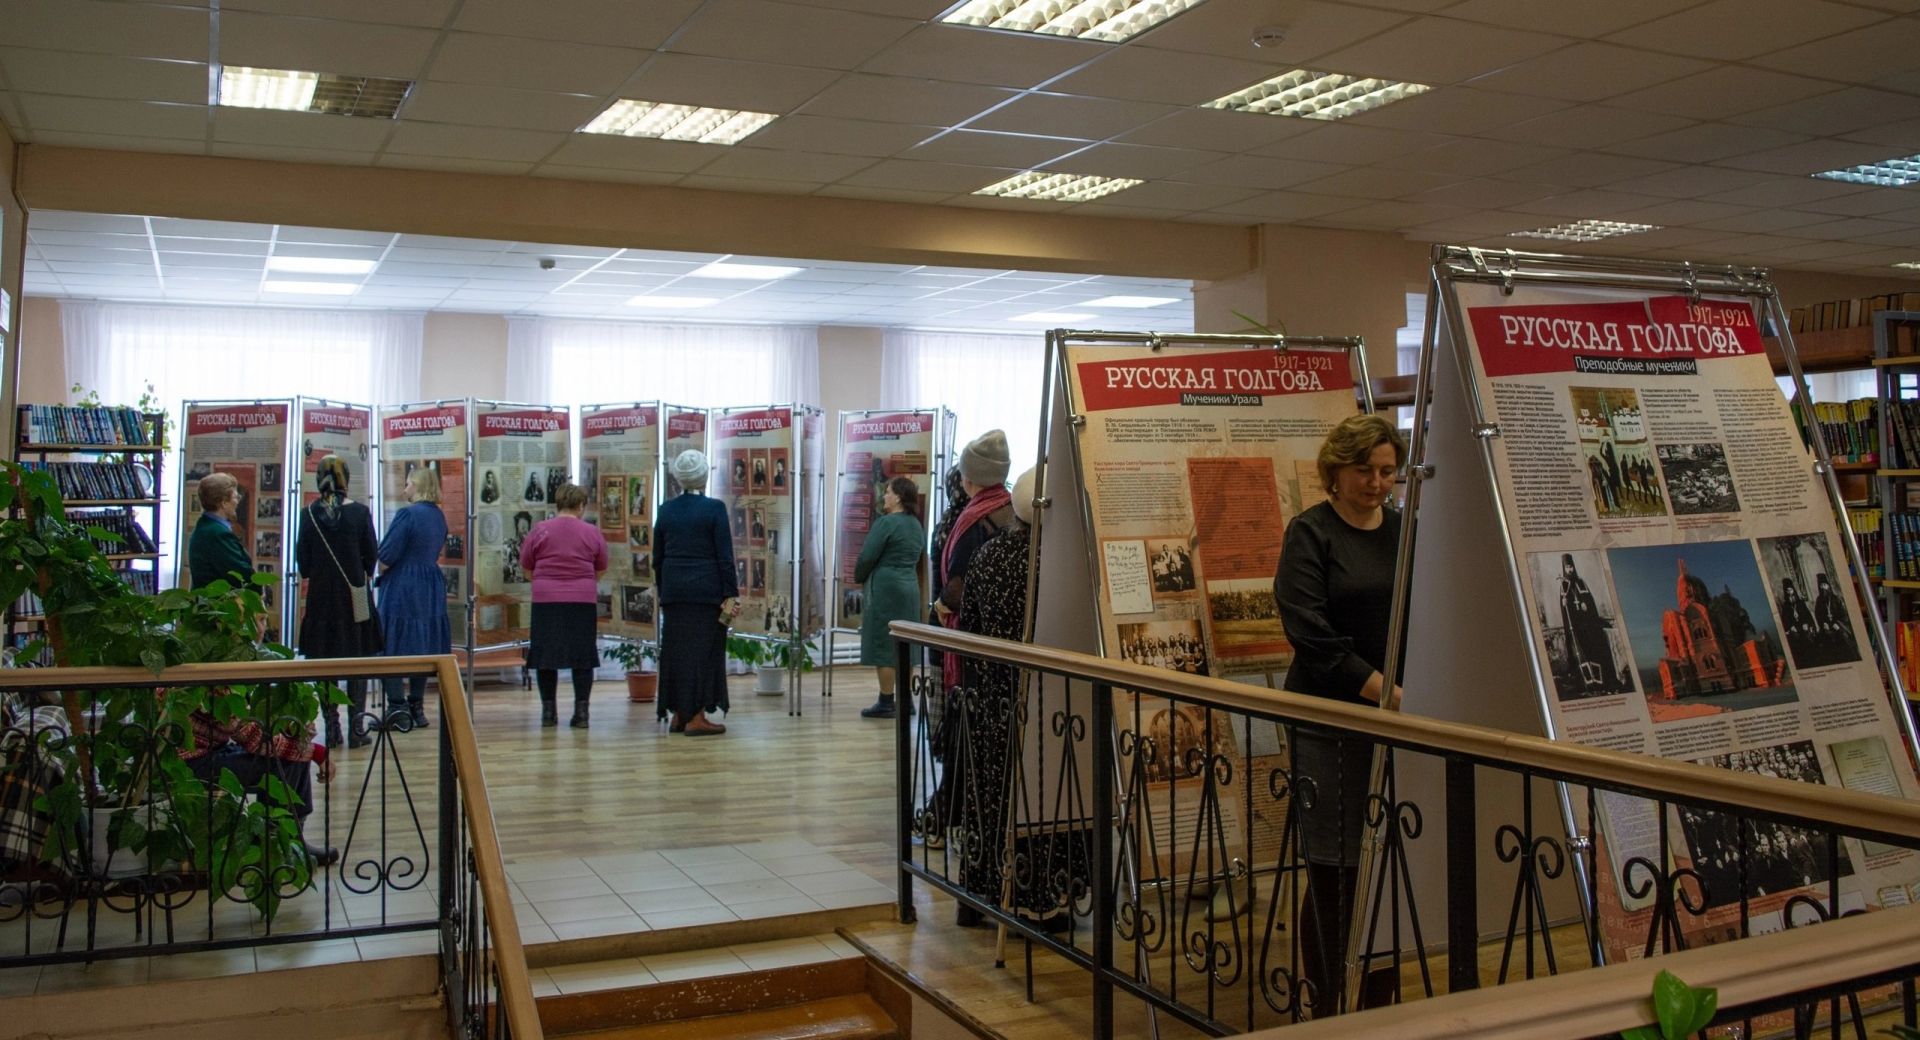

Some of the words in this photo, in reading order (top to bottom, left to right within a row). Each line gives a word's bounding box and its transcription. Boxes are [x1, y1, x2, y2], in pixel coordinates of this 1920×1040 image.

[1686, 305, 1751, 328] 1917-1921
[1500, 314, 1624, 351] РУССКАЯ
[1627, 322, 1745, 354] ГОЛГОФА
[1273, 355, 1334, 371] 1917-1921
[1575, 355, 1644, 372] Преподобные
[1645, 360, 1696, 375] мученики
[1105, 367, 1217, 390] РУССКАЯ
[1223, 369, 1325, 391] ГОЛГОФА
[1183, 394, 1230, 406] Мученики
[1231, 394, 1260, 406] Урала
[197, 413, 236, 425] РУССКАЯ
[238, 413, 277, 425] ГОЛГОФА
[310, 412, 337, 426] РУССКАЯ
[390, 417, 422, 431] РУССКАЯ
[423, 416, 457, 429] ГОЛГОФА
[486, 416, 521, 429] РУССКАЯ
[523, 417, 560, 431] ГОЛГОФА
[613, 415, 648, 428] ГОЛГОФА
[750, 417, 783, 430] ГОЛГОФА
[853, 423, 885, 434] РУССКАЯ
[886, 421, 922, 433] ГОЛГОФА
